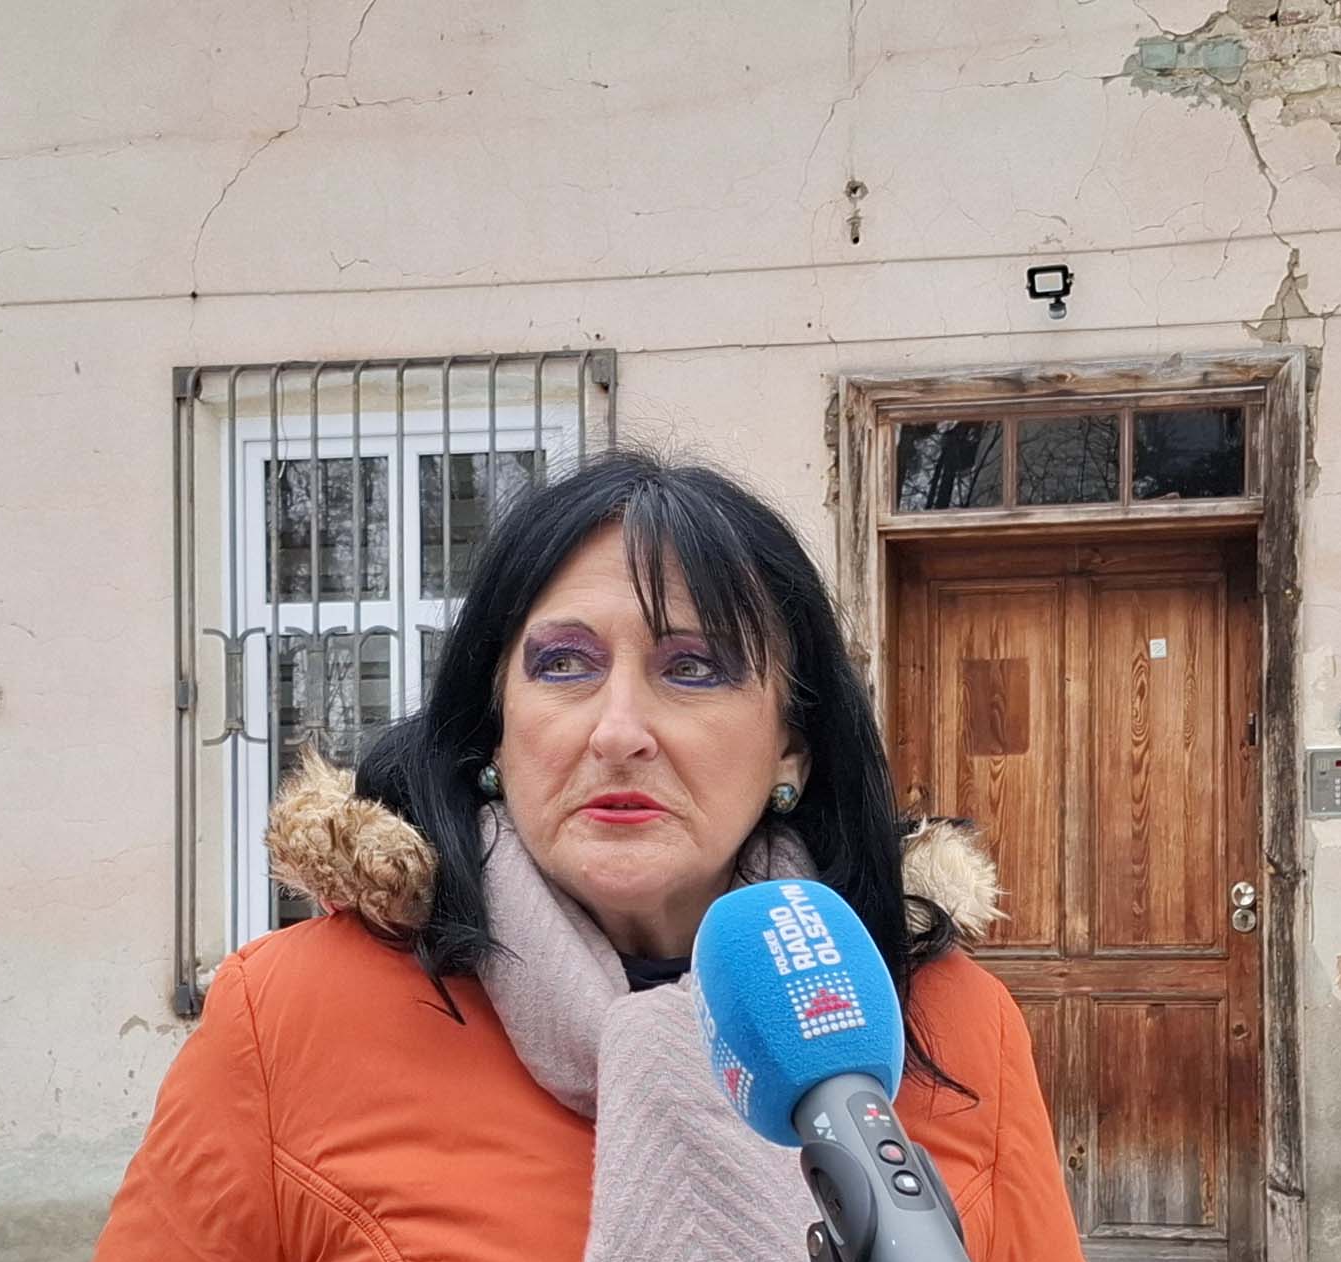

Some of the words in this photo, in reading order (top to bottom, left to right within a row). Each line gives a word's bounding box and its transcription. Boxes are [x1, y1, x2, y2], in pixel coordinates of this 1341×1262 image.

[762, 929, 791, 976] POLSKIE
[769, 906, 817, 970] RADIO
[779, 884, 841, 965] OLSZTYN
